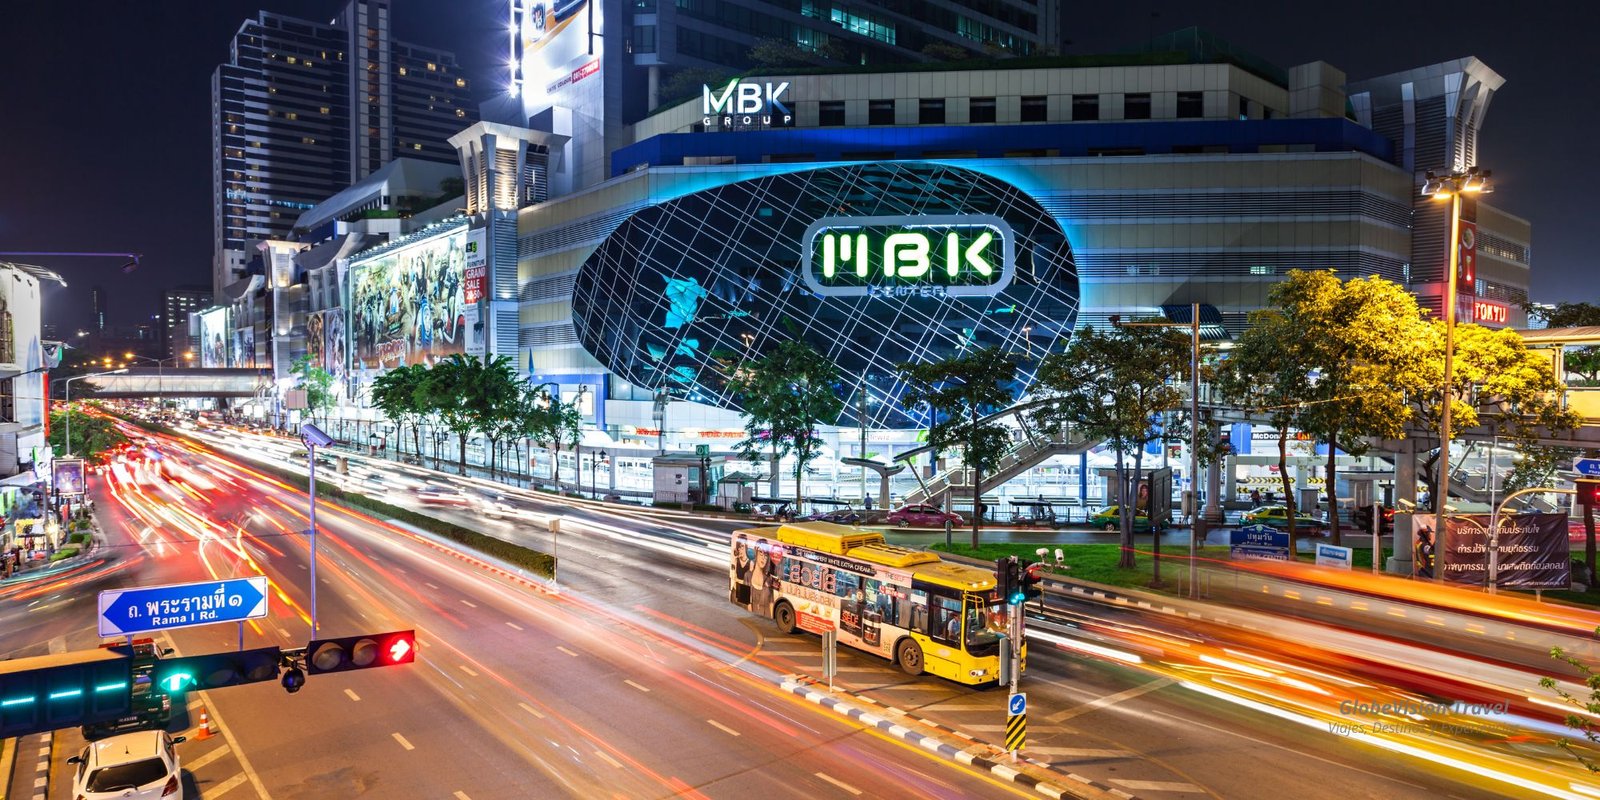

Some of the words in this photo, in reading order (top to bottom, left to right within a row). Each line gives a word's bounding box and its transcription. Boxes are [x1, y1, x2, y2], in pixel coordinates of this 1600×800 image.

[703, 78, 791, 115] MBK
[703, 115, 791, 126] GROUP
[823, 232, 993, 278] MBK
[467, 267, 485, 279] GRAND
[467, 279, 479, 289] SALE
[867, 285, 944, 298] CENTER
[1475, 303, 1507, 322] TOKYU
[128, 605, 142, 618] ถ.
[146, 583, 225, 616] พระรามที่
[228, 594, 243, 607] ๑
[152, 615, 187, 626] Rama
[191, 612, 195, 621] I
[200, 610, 219, 620] Rd.
